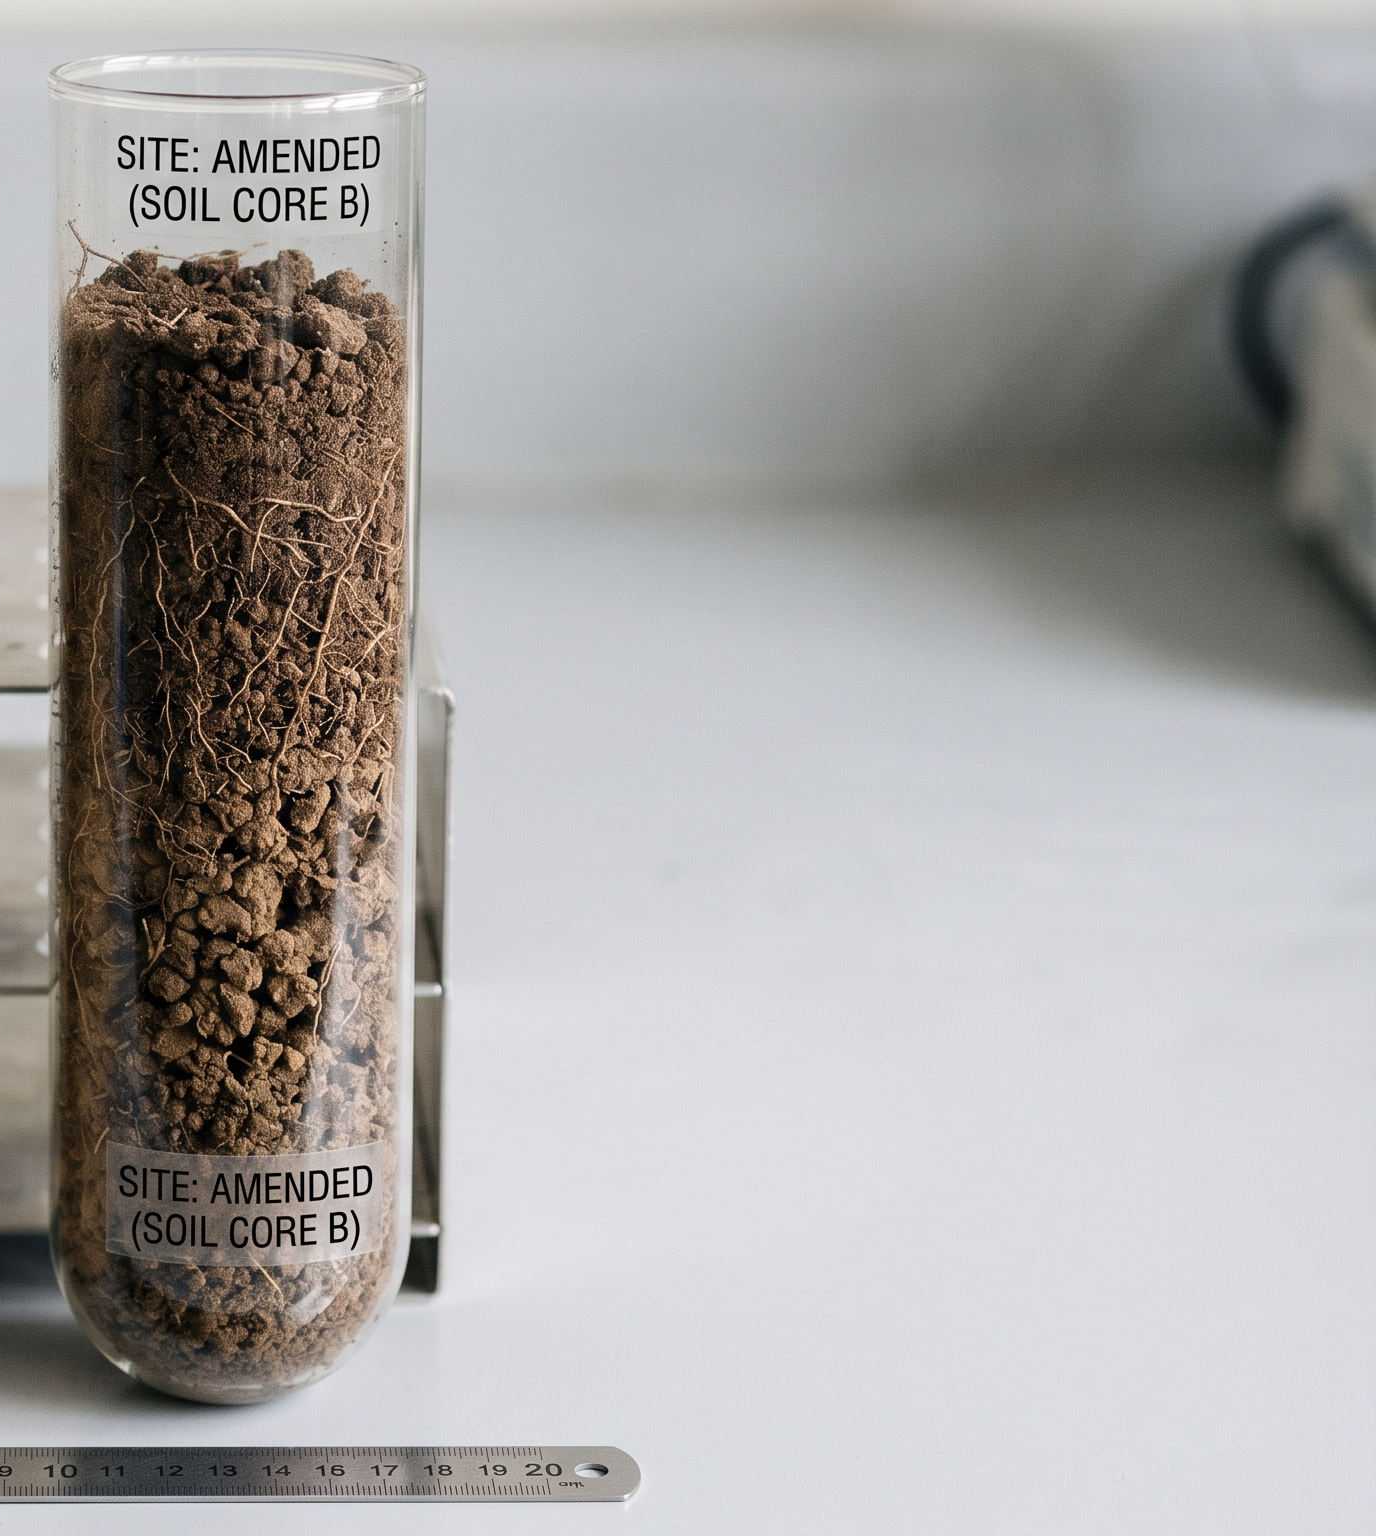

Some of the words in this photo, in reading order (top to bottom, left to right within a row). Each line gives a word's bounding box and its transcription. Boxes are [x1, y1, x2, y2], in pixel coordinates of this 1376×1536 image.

[117, 135, 199, 173] SITE:
[211, 135, 381, 174] AMENDED
[129, 183, 220, 228] (SOIL
[233, 186, 328, 223] CORE
[340, 183, 369, 227] B)
[118, 1164, 198, 1203] SITE:
[209, 1165, 373, 1205] AMENDED
[131, 1210, 219, 1253] (SOIL
[229, 1213, 317, 1249] CORE
[329, 1209, 360, 1251] B)
[43, 1464, 78, 1478] 10
[100, 1465, 124, 1477] 11
[155, 1465, 184, 1477] 12
[208, 1465, 238, 1477] 13
[262, 1465, 291, 1477] 14
[315, 1464, 346, 1477] 16
[370, 1465, 399, 1477] 17
[423, 1464, 453, 1476] 18
[479, 1464, 508, 1476] 19
[524, 1463, 562, 1477] 20
